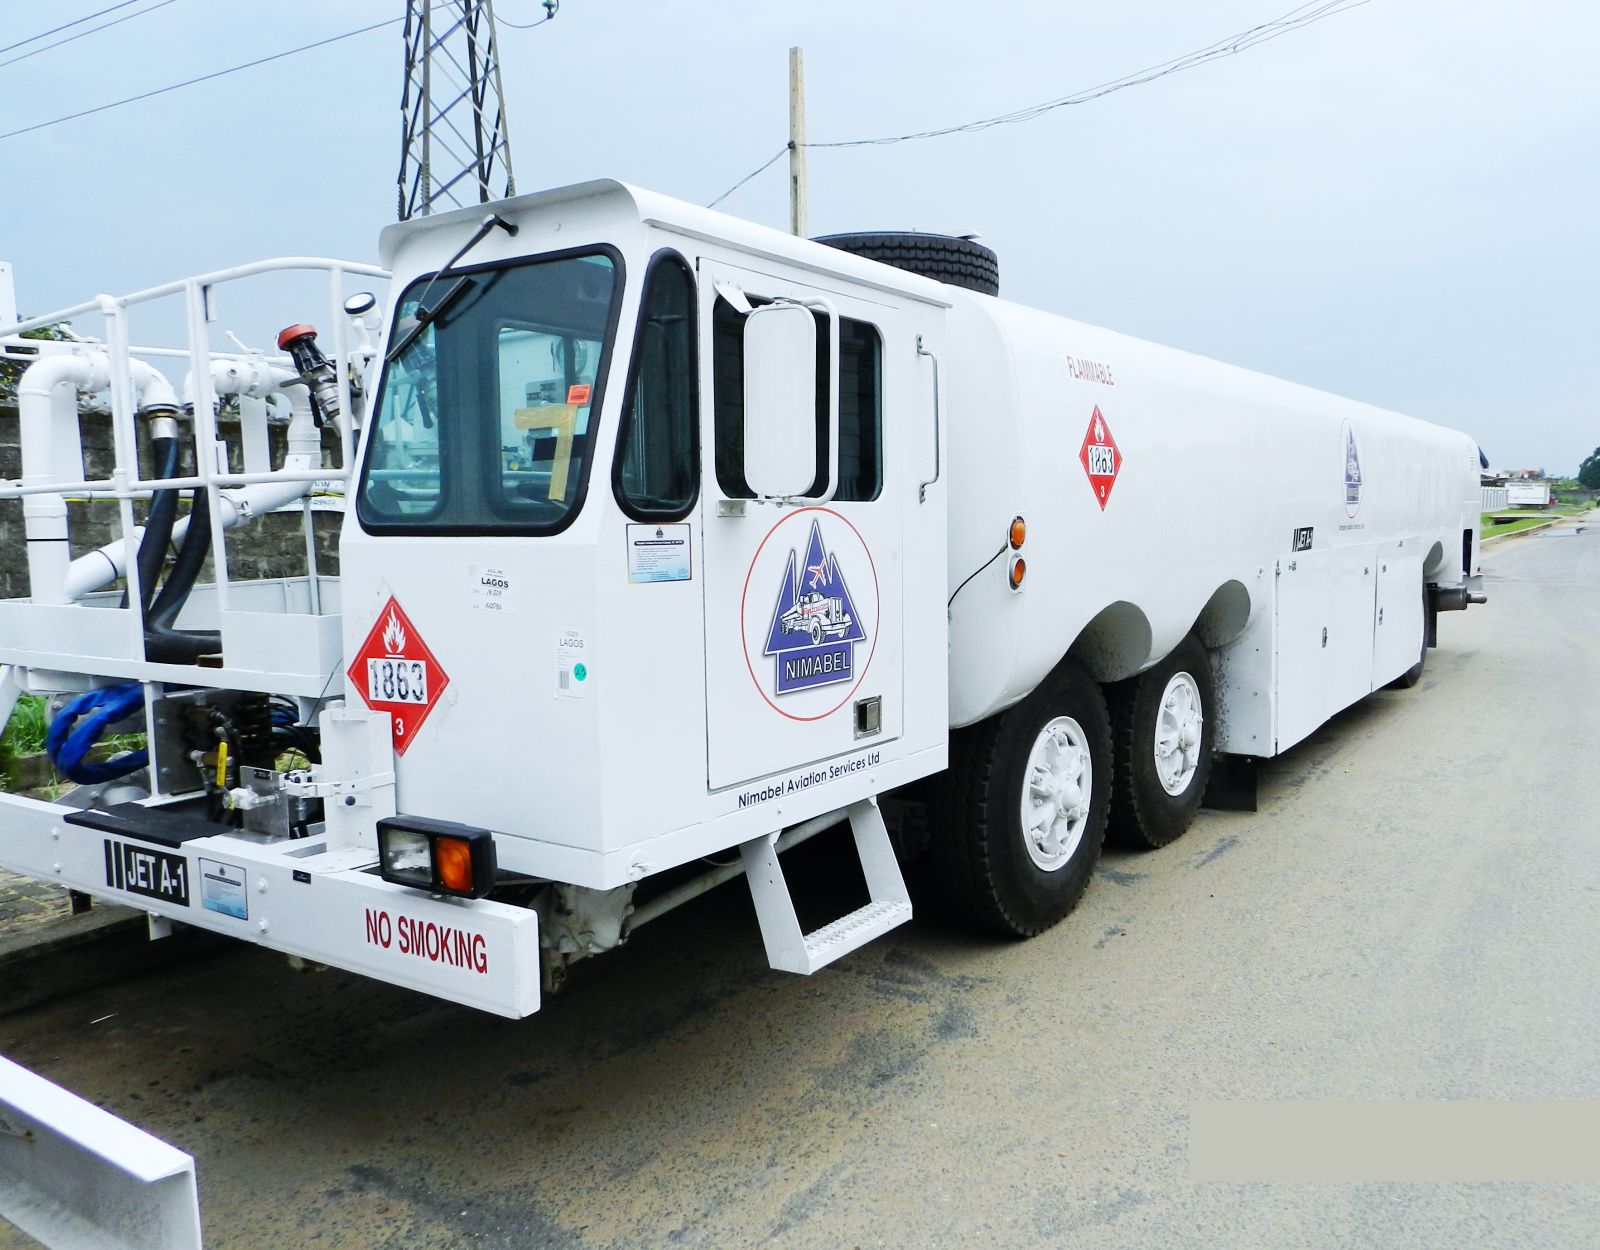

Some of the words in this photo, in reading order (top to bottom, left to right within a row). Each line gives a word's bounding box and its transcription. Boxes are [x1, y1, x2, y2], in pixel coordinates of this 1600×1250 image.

[1066, 355, 1114, 386] FLAMMABLE
[1089, 446, 1114, 474] 1863
[1100, 485, 1106, 498] 3
[481, 577, 509, 588] LAGOS
[559, 638, 584, 648] LAGOS
[786, 652, 850, 680] NIMABEL
[370, 660, 425, 702] 1863
[395, 717, 405, 736] 3
[738, 782, 784, 808] Nimabel
[787, 771, 827, 793] Aviation
[829, 758, 866, 779] Services
[867, 751, 880, 766] Ltd
[127, 851, 156, 890] JET
[160, 858, 186, 899] A-1
[365, 908, 392, 949] NO
[398, 915, 488, 974] SMOKING
